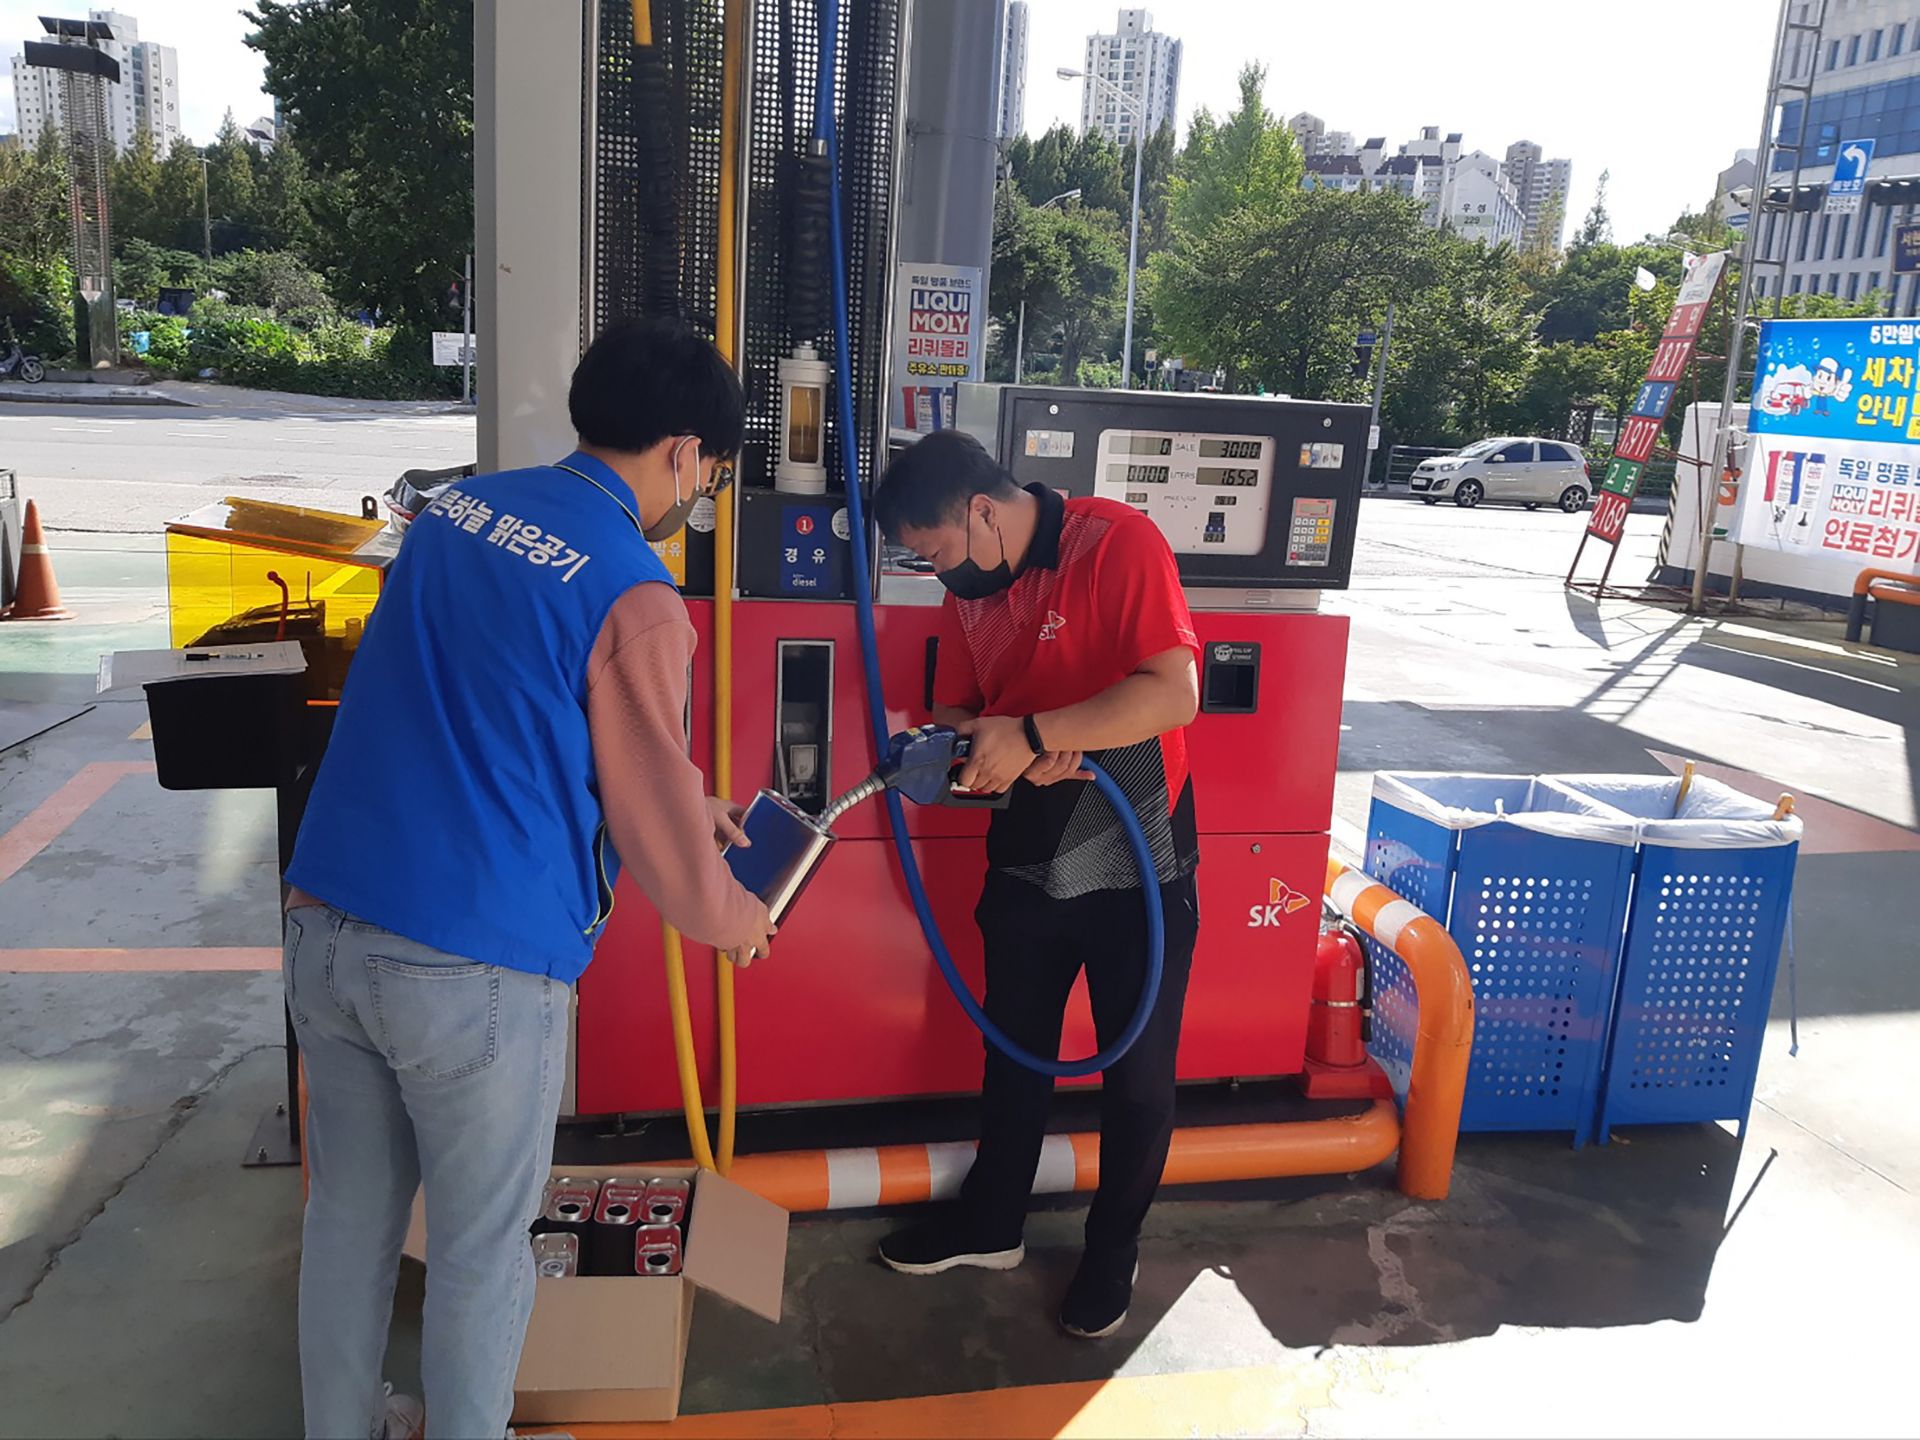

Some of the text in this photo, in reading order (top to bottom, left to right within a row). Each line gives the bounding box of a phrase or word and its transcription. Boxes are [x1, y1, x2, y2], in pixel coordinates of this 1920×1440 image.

[913, 290, 969, 312] LIQUI
[912, 312, 969, 333] MOLY
[908, 338, 968, 358] 리퀴몰리
[907, 361, 937, 375] 주유소
[1861, 356, 1915, 389] 세차
[1856, 394, 1908, 427] 안내
[1174, 443, 1196, 452] SALE
[1220, 441, 1261, 459] 3000
[1839, 458, 1871, 481] 독일
[1876, 462, 1910, 486] 명품
[1834, 485, 1867, 503] LIQUI
[1830, 499, 1865, 515] MOLY
[486, 513, 591, 583] 맑은공기
[792, 577, 817, 587] diesel
[1247, 904, 1282, 928] SK
